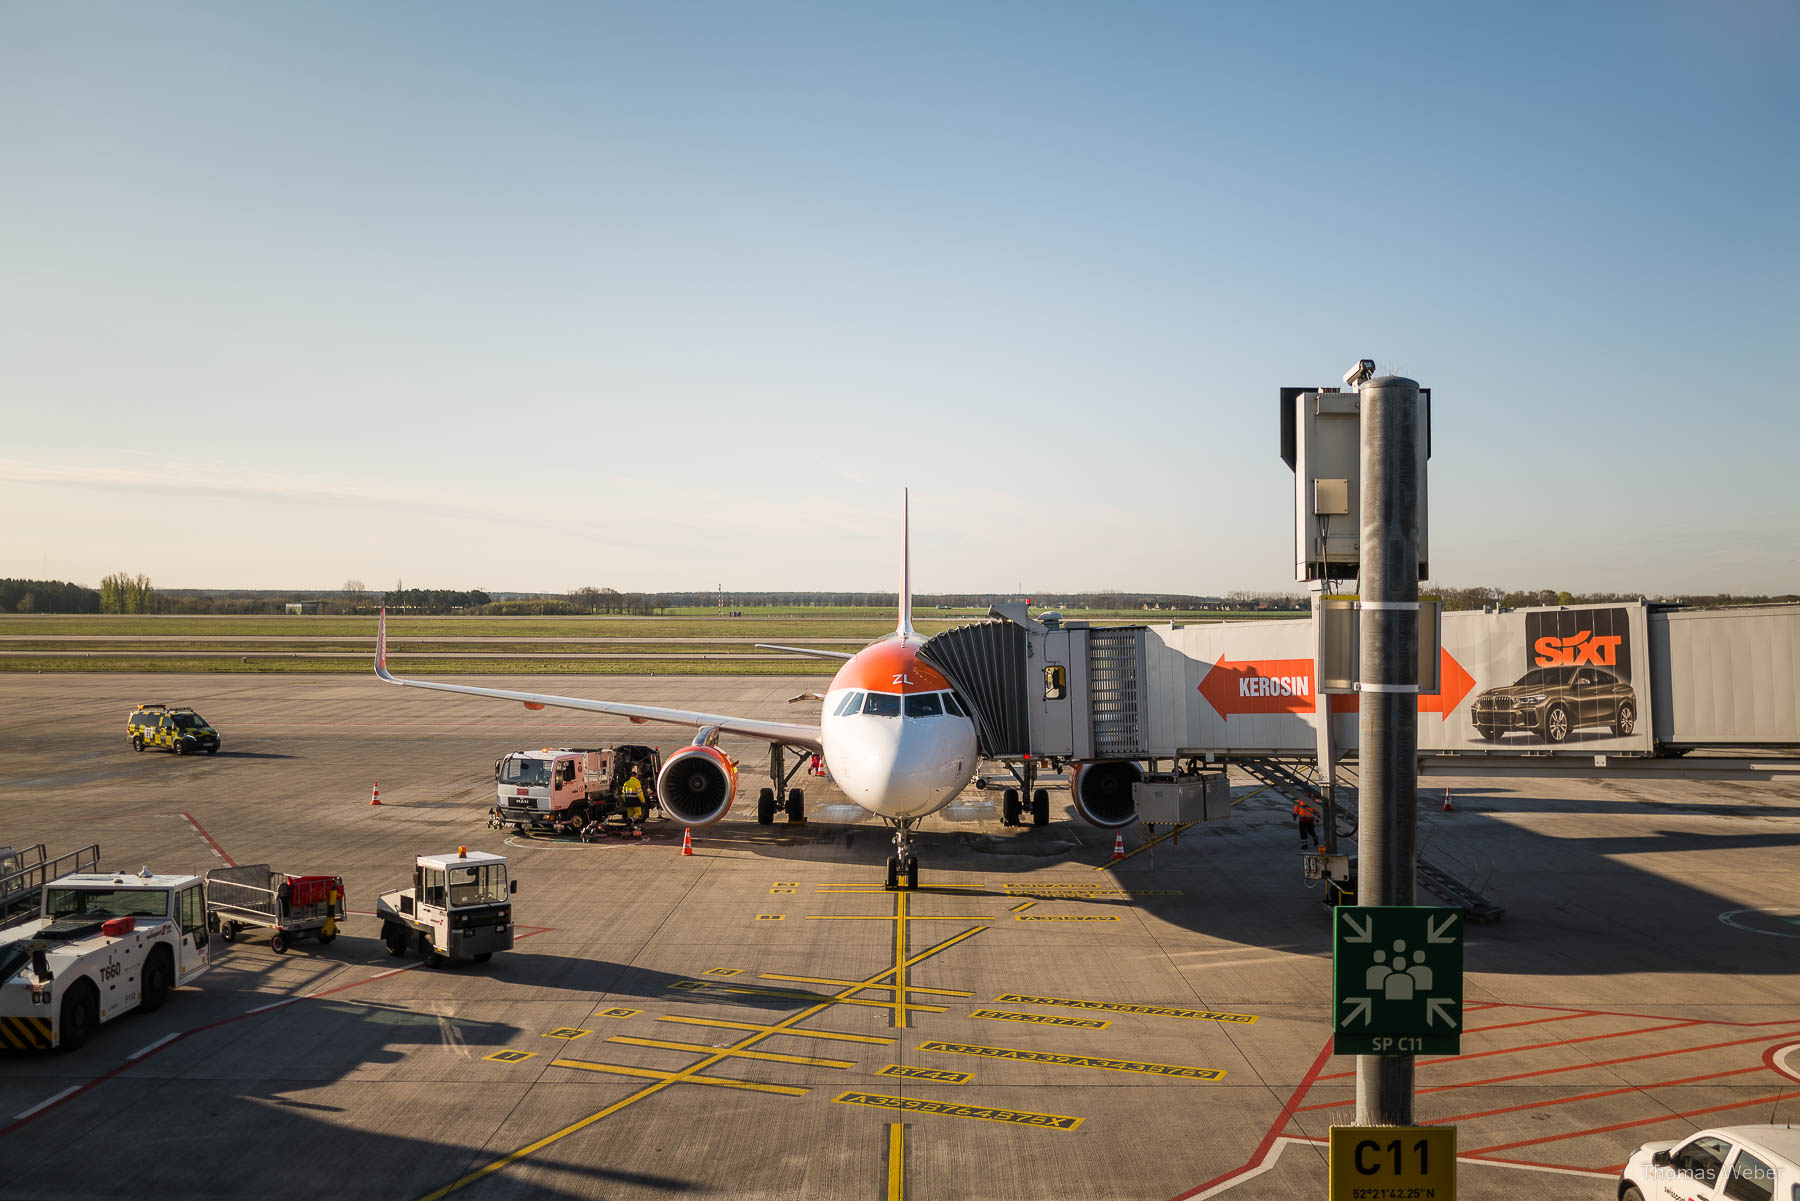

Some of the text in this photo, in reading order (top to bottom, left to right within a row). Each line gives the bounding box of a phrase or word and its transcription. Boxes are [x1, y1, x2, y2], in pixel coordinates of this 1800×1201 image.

[892, 673, 914, 685] ZL
[1239, 676, 1309, 698] KEROSIN
[100, 962, 120, 982] T660
[1372, 1037, 1423, 1051] SP C11
[1354, 1139, 1429, 1176] C11
